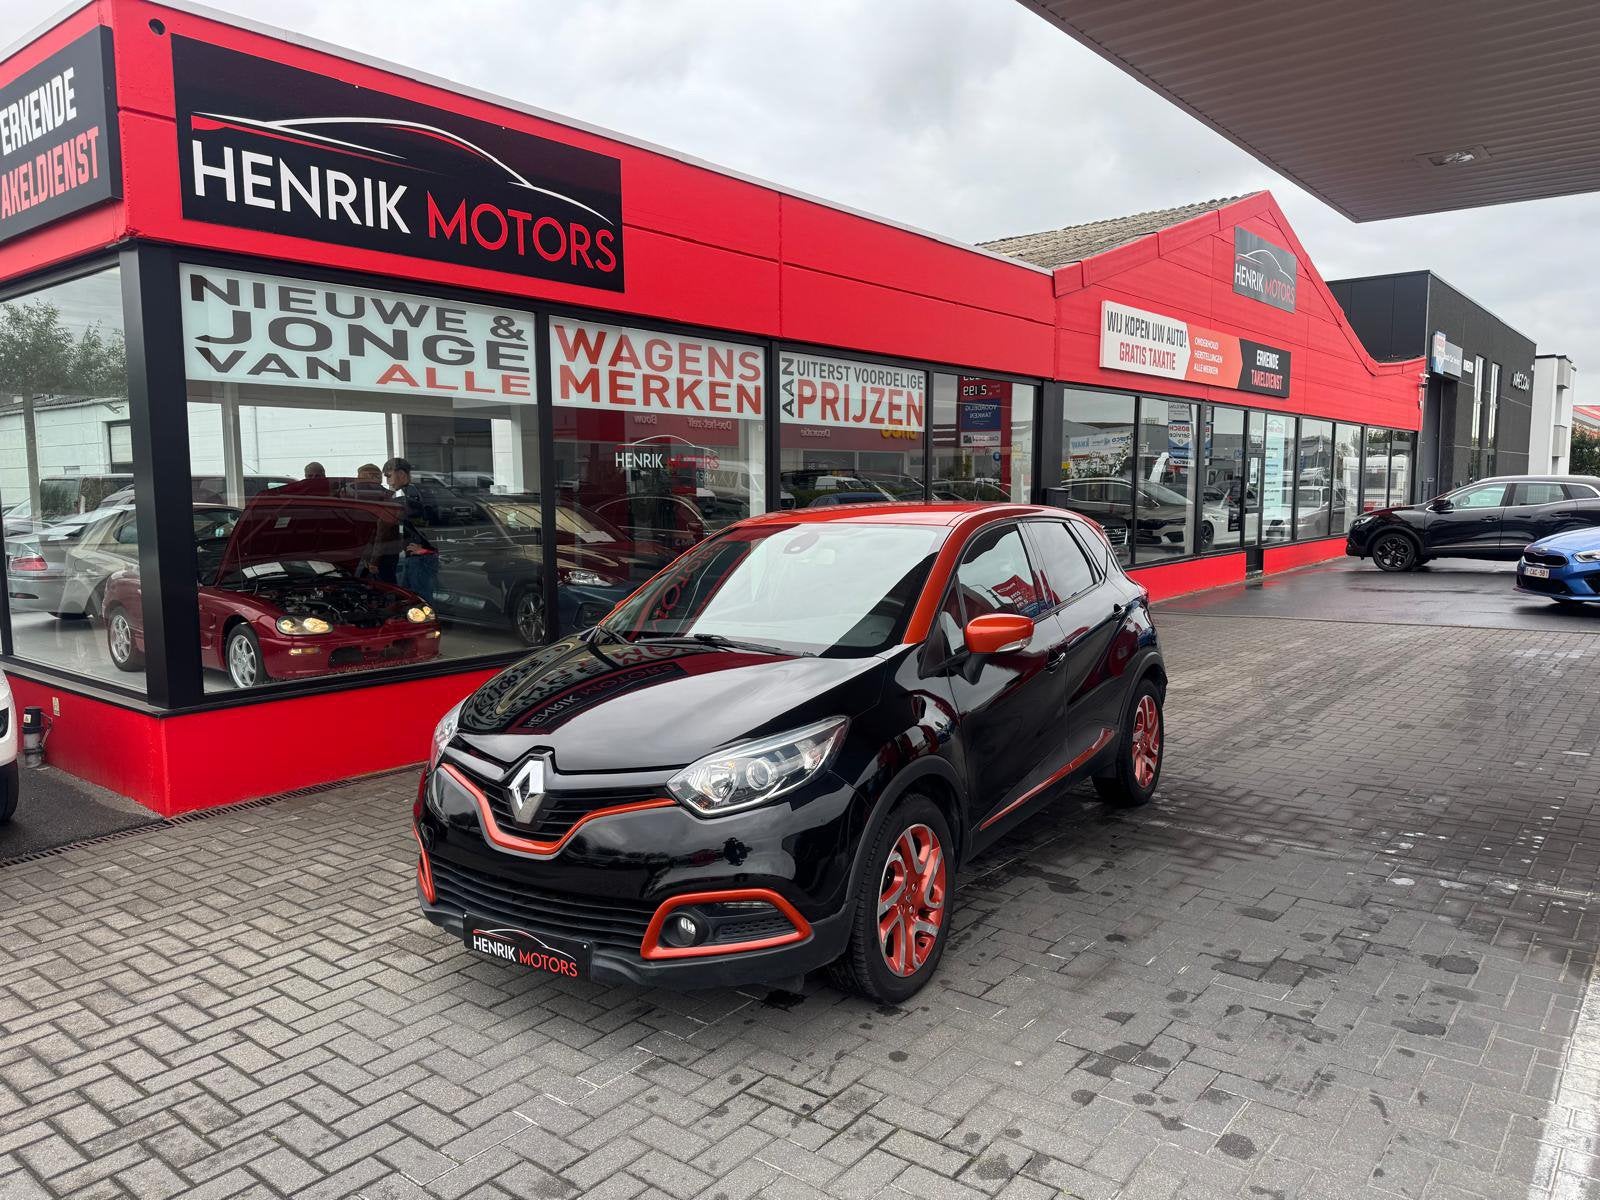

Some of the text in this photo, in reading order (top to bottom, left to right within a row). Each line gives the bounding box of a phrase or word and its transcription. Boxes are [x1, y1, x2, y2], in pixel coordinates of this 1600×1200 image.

[0, 67, 77, 156] ERKENDE
[192, 140, 617, 273] HENRIK MOTORS
[190, 274, 526, 342] NIEUWE &
[1234, 263, 1296, 305] HENRIK MOTORS
[195, 310, 530, 374] JONGE
[555, 325, 761, 382] WAGENS
[1107, 310, 1187, 349] WIJ KOPEN UW AUTO!
[194, 347, 531, 396] VAN ALLE
[797, 360, 924, 390] UITERST VOORDELIGE
[1119, 342, 1176, 371] GRATIS TAXATIE
[1251, 369, 1283, 391] TAKELDIENST
[1256, 349, 1279, 370] ERKENDE
[560, 365, 762, 415] MERKEN
[781, 358, 795, 417] AAN
[797, 378, 924, 427] PRIJZEN
[615, 452, 663, 469] HENRIK
[473, 935, 578, 978] HENRIK MOTORS
